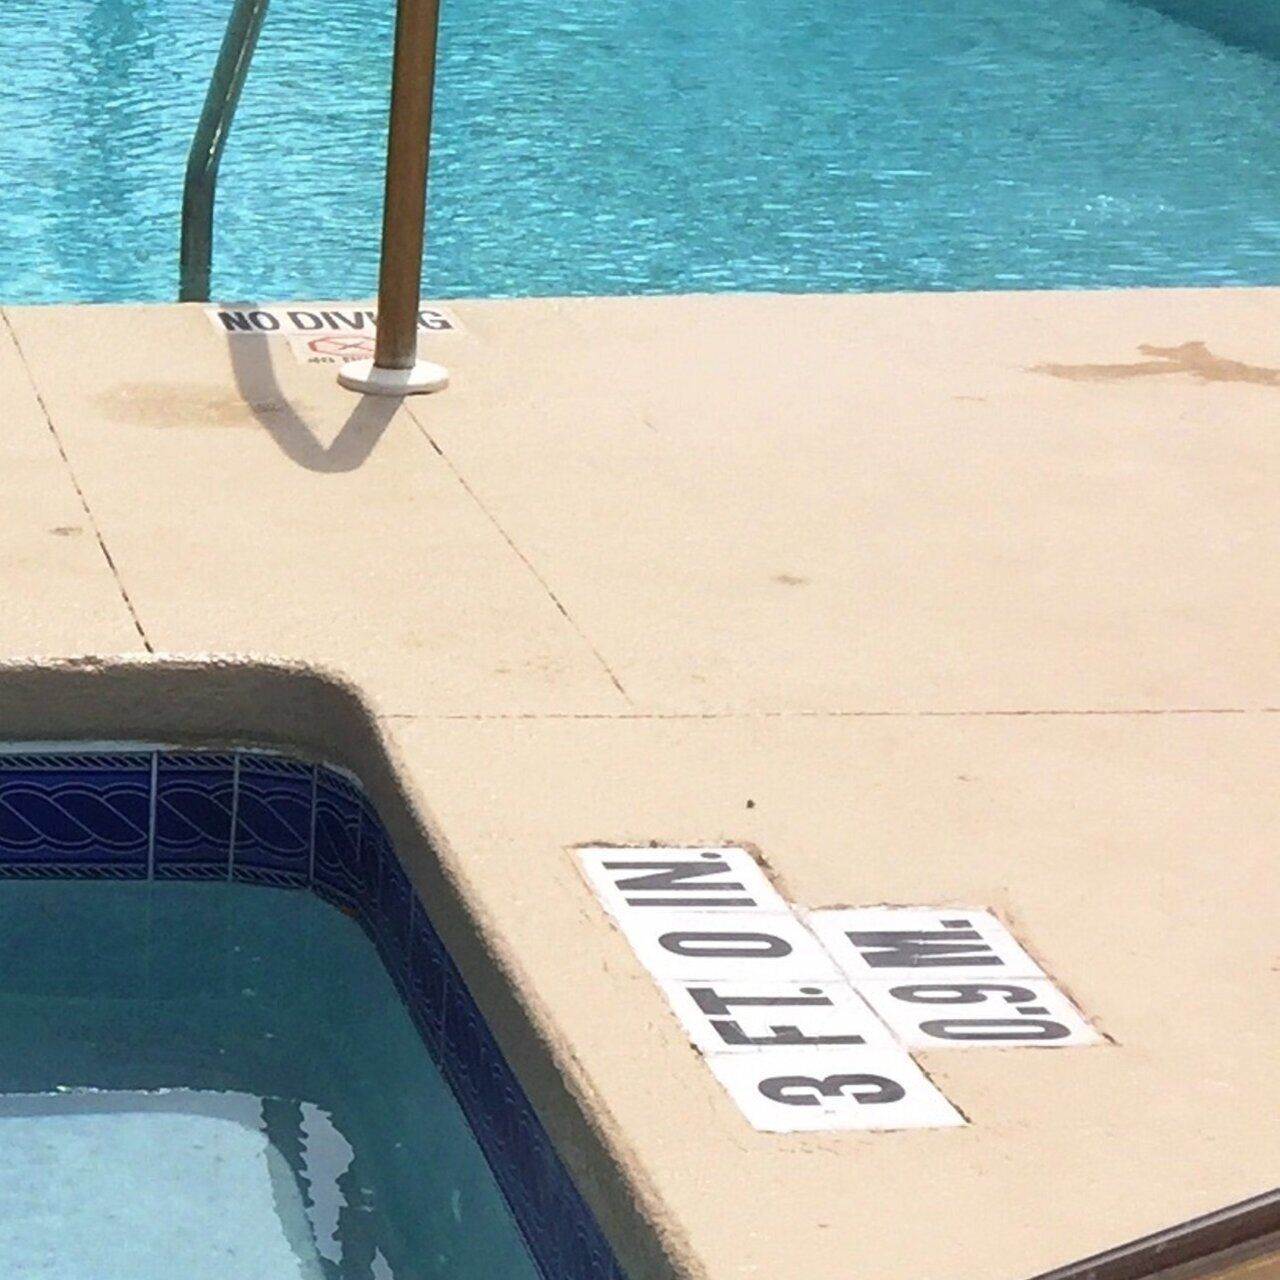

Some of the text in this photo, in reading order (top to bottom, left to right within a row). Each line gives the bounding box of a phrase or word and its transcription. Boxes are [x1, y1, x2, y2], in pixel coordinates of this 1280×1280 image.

[218, 310, 453, 331] NO DIVG
[658, 931, 793, 959] 0
[888, 983, 1072, 1041] 0.9
[758, 1073, 906, 1106] 3
